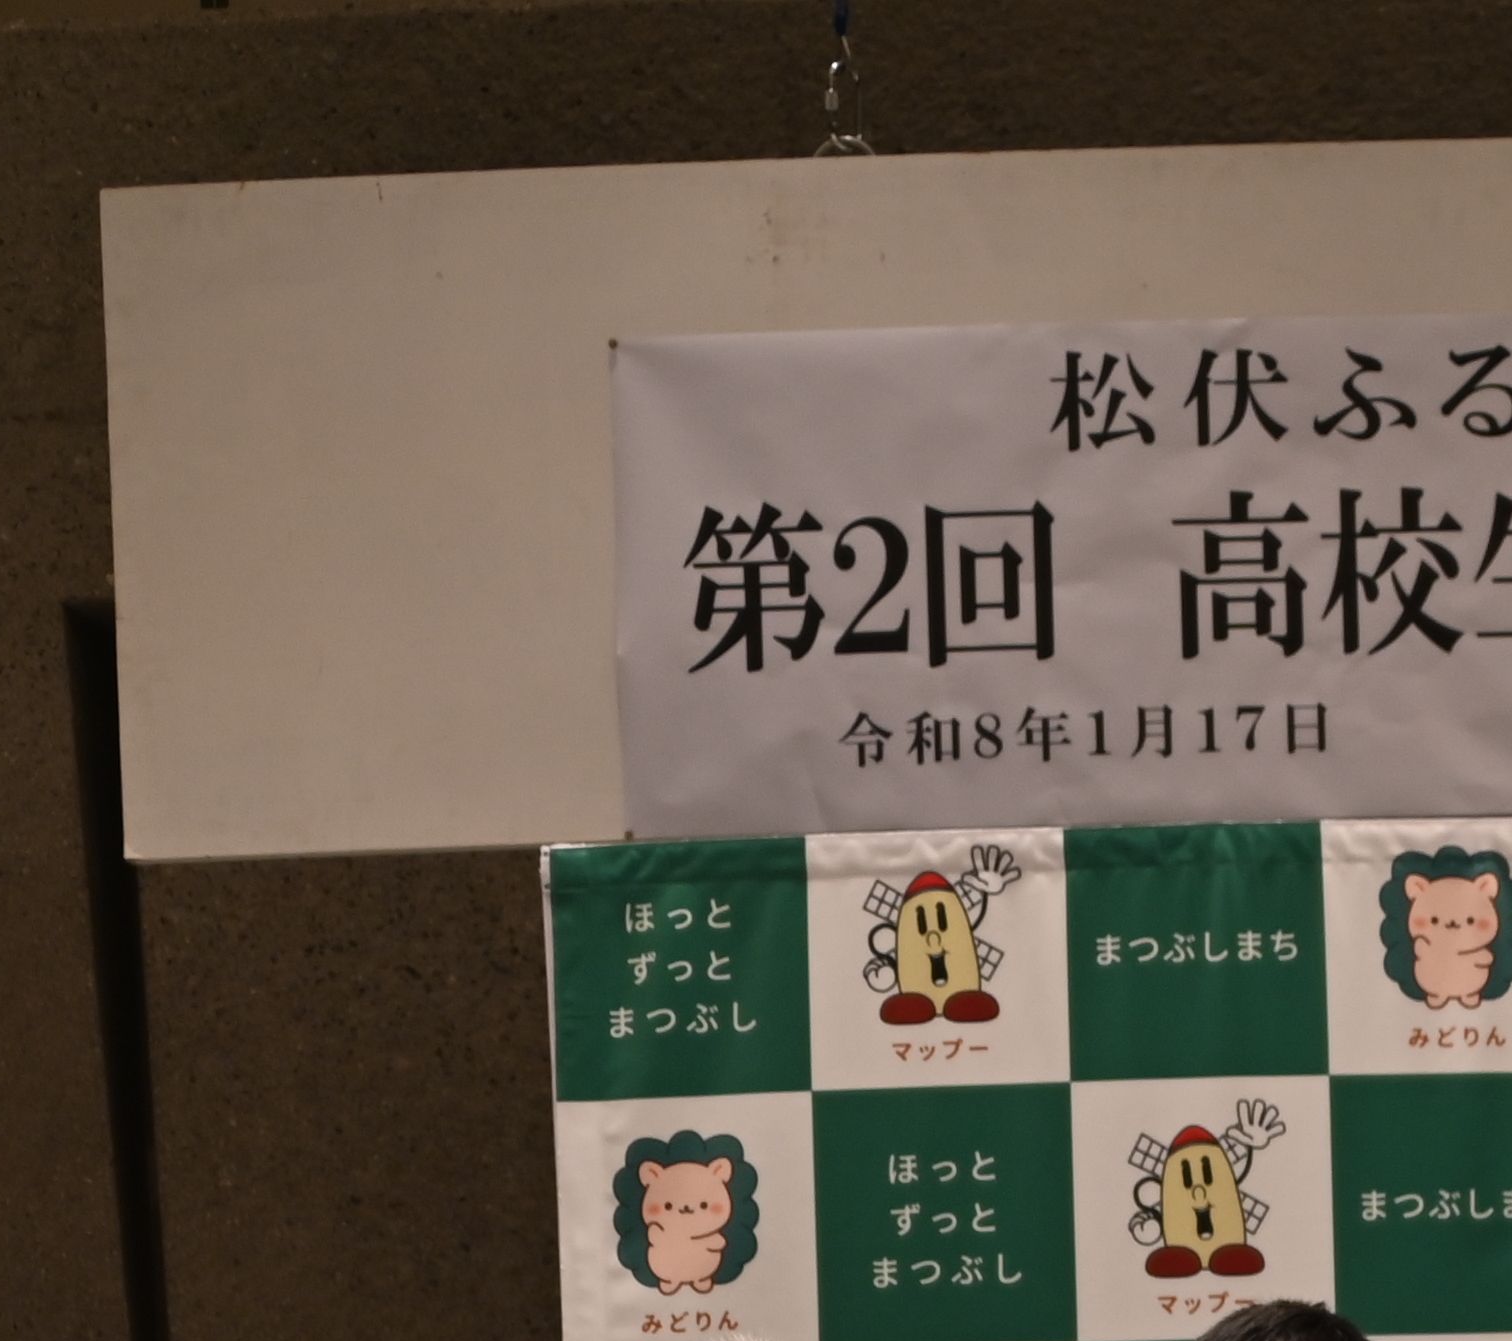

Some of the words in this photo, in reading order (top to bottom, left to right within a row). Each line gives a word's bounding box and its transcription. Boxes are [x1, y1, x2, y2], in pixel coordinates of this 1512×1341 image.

[683, 500, 1055, 674] 第2回
[839, 702, 1327, 769] 令和8年1月17日
[625, 898, 731, 933] ほっと
[1096, 930, 1298, 966] まつぶしまち
[627, 950, 731, 985] ずっと
[609, 1001, 757, 1039] まつぶし
[1408, 1026, 1507, 1049] みどりん
[892, 1037, 989, 1062] マップー
[888, 1150, 996, 1185] ほっと
[890, 1202, 996, 1236] ずっと
[872, 1253, 1022, 1289] まつぶし
[641, 1310, 739, 1334] みどりん
